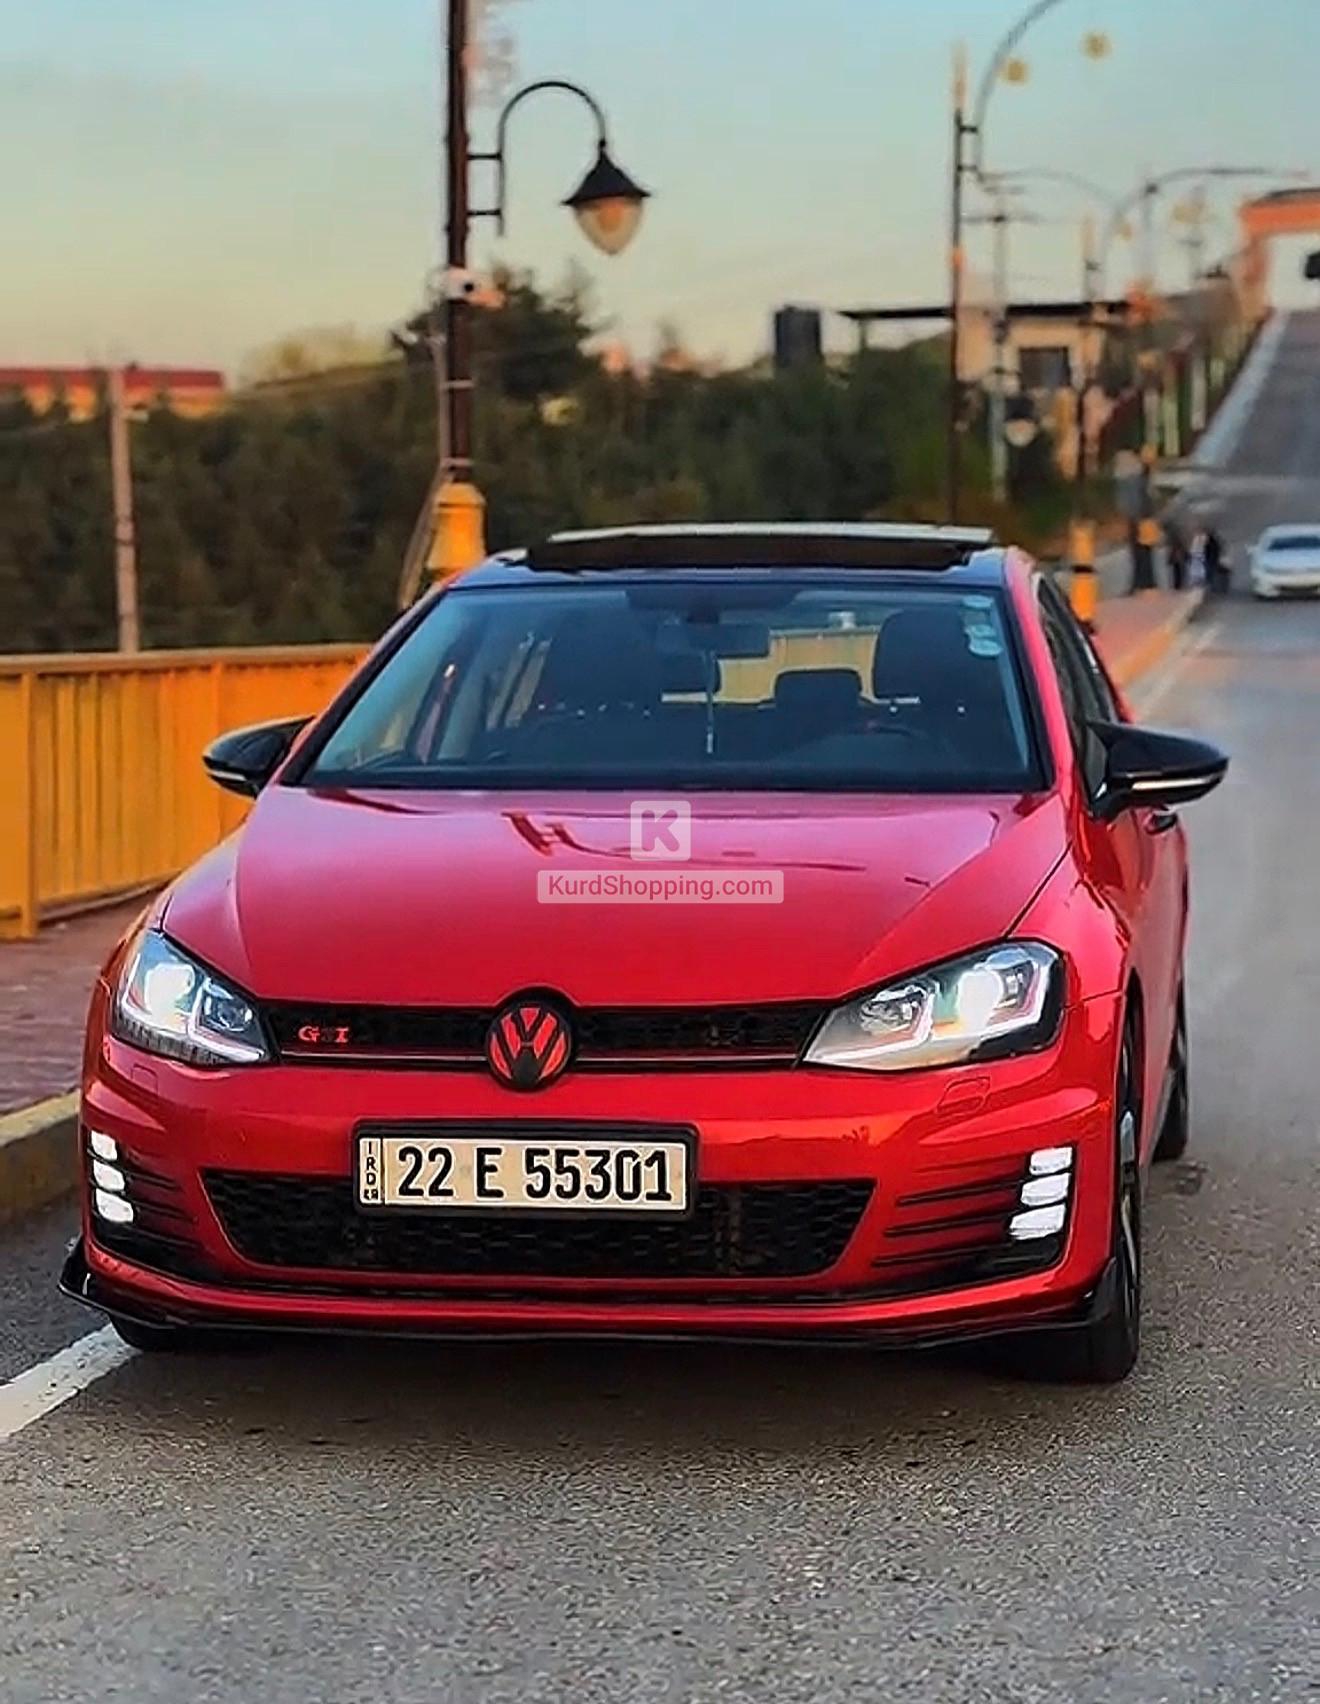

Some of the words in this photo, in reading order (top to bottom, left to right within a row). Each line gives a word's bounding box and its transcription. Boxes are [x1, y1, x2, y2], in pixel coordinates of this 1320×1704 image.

[398, 1147, 454, 1197] 22
[476, 1147, 504, 1199] E
[525, 1149, 672, 1201] 55301
